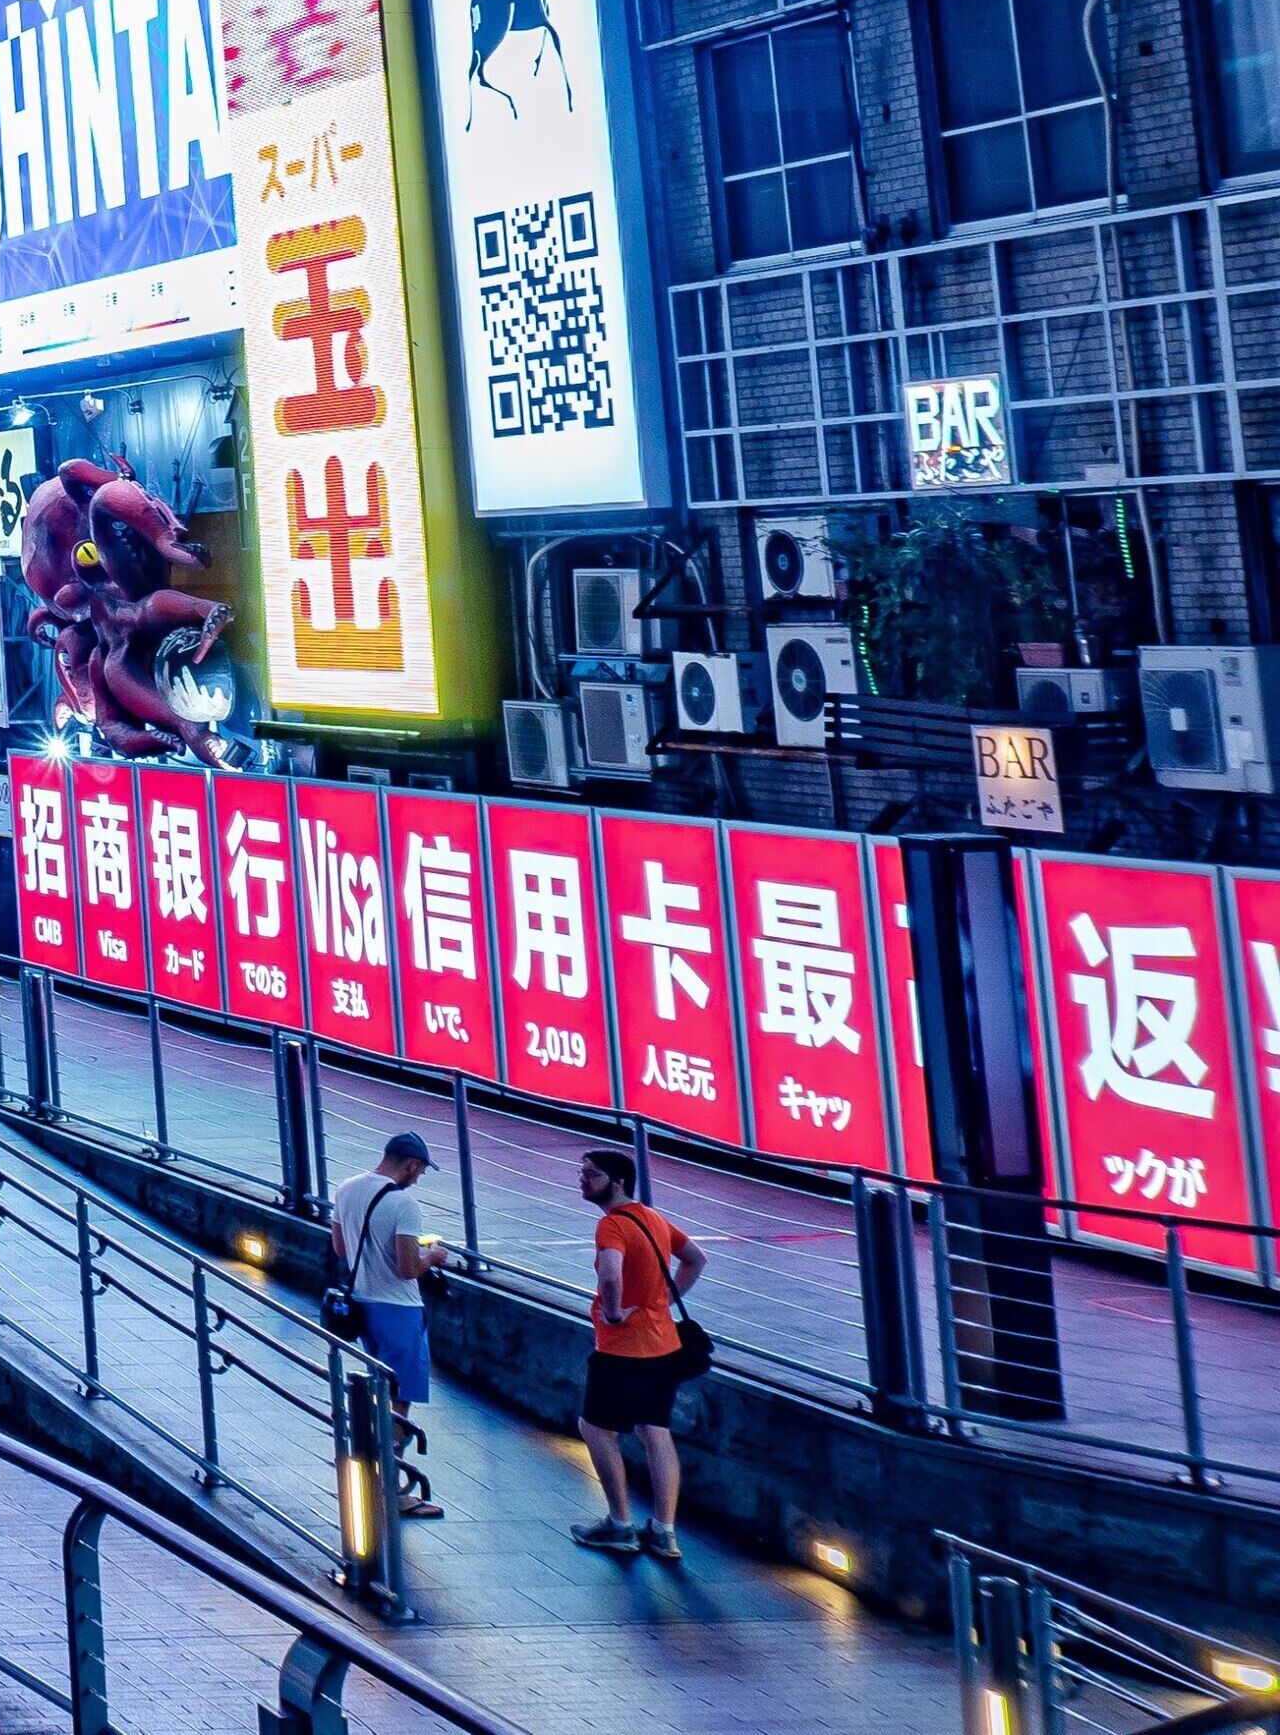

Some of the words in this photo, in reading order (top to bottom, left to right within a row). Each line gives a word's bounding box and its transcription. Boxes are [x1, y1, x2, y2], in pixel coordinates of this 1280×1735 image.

[258, 119, 365, 205] スーパー
[265, 213, 404, 672] 玉出
[907, 377, 1003, 453] BAR
[975, 734, 1057, 783] BAR
[985, 792, 1055, 821] ふたごや
[300, 816, 388, 967] Visa
[34, 915, 62, 947] CMB
[96, 928, 128, 962] Visa
[165, 943, 206, 981] カード
[240, 961, 287, 1000] でのお
[332, 977, 370, 1020] 支払
[525, 1021, 587, 1069] 2,019
[642, 1044, 717, 1102] 人民元
[1067, 912, 1216, 1120] 返
